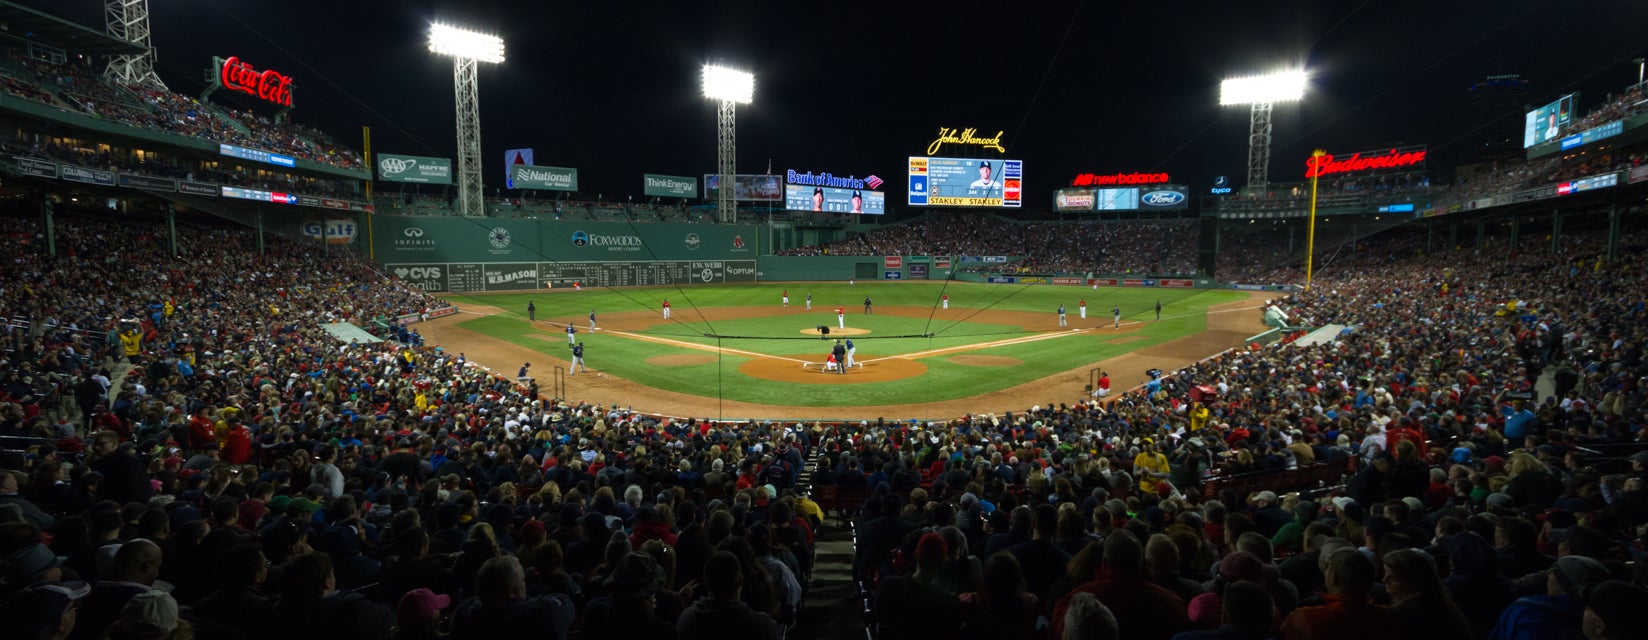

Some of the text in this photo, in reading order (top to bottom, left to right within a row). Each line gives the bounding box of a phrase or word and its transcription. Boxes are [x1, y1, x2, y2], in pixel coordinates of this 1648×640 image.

[927, 127, 1005, 155] John Hancock
[1305, 148, 1427, 178] Budweiser
[530, 170, 571, 183] National
[787, 169, 864, 189] Bank of America
[1094, 175, 1116, 184] new
[1117, 172, 1169, 184] balance
[648, 178, 692, 191] ThinkEnergy
[1149, 193, 1176, 204] Ford
[305, 223, 353, 235] Gulf
[589, 234, 641, 246] FOXWOODS
[410, 267, 441, 279] CVS
[733, 268, 754, 276] OPTUM
[407, 280, 441, 291] ealth
